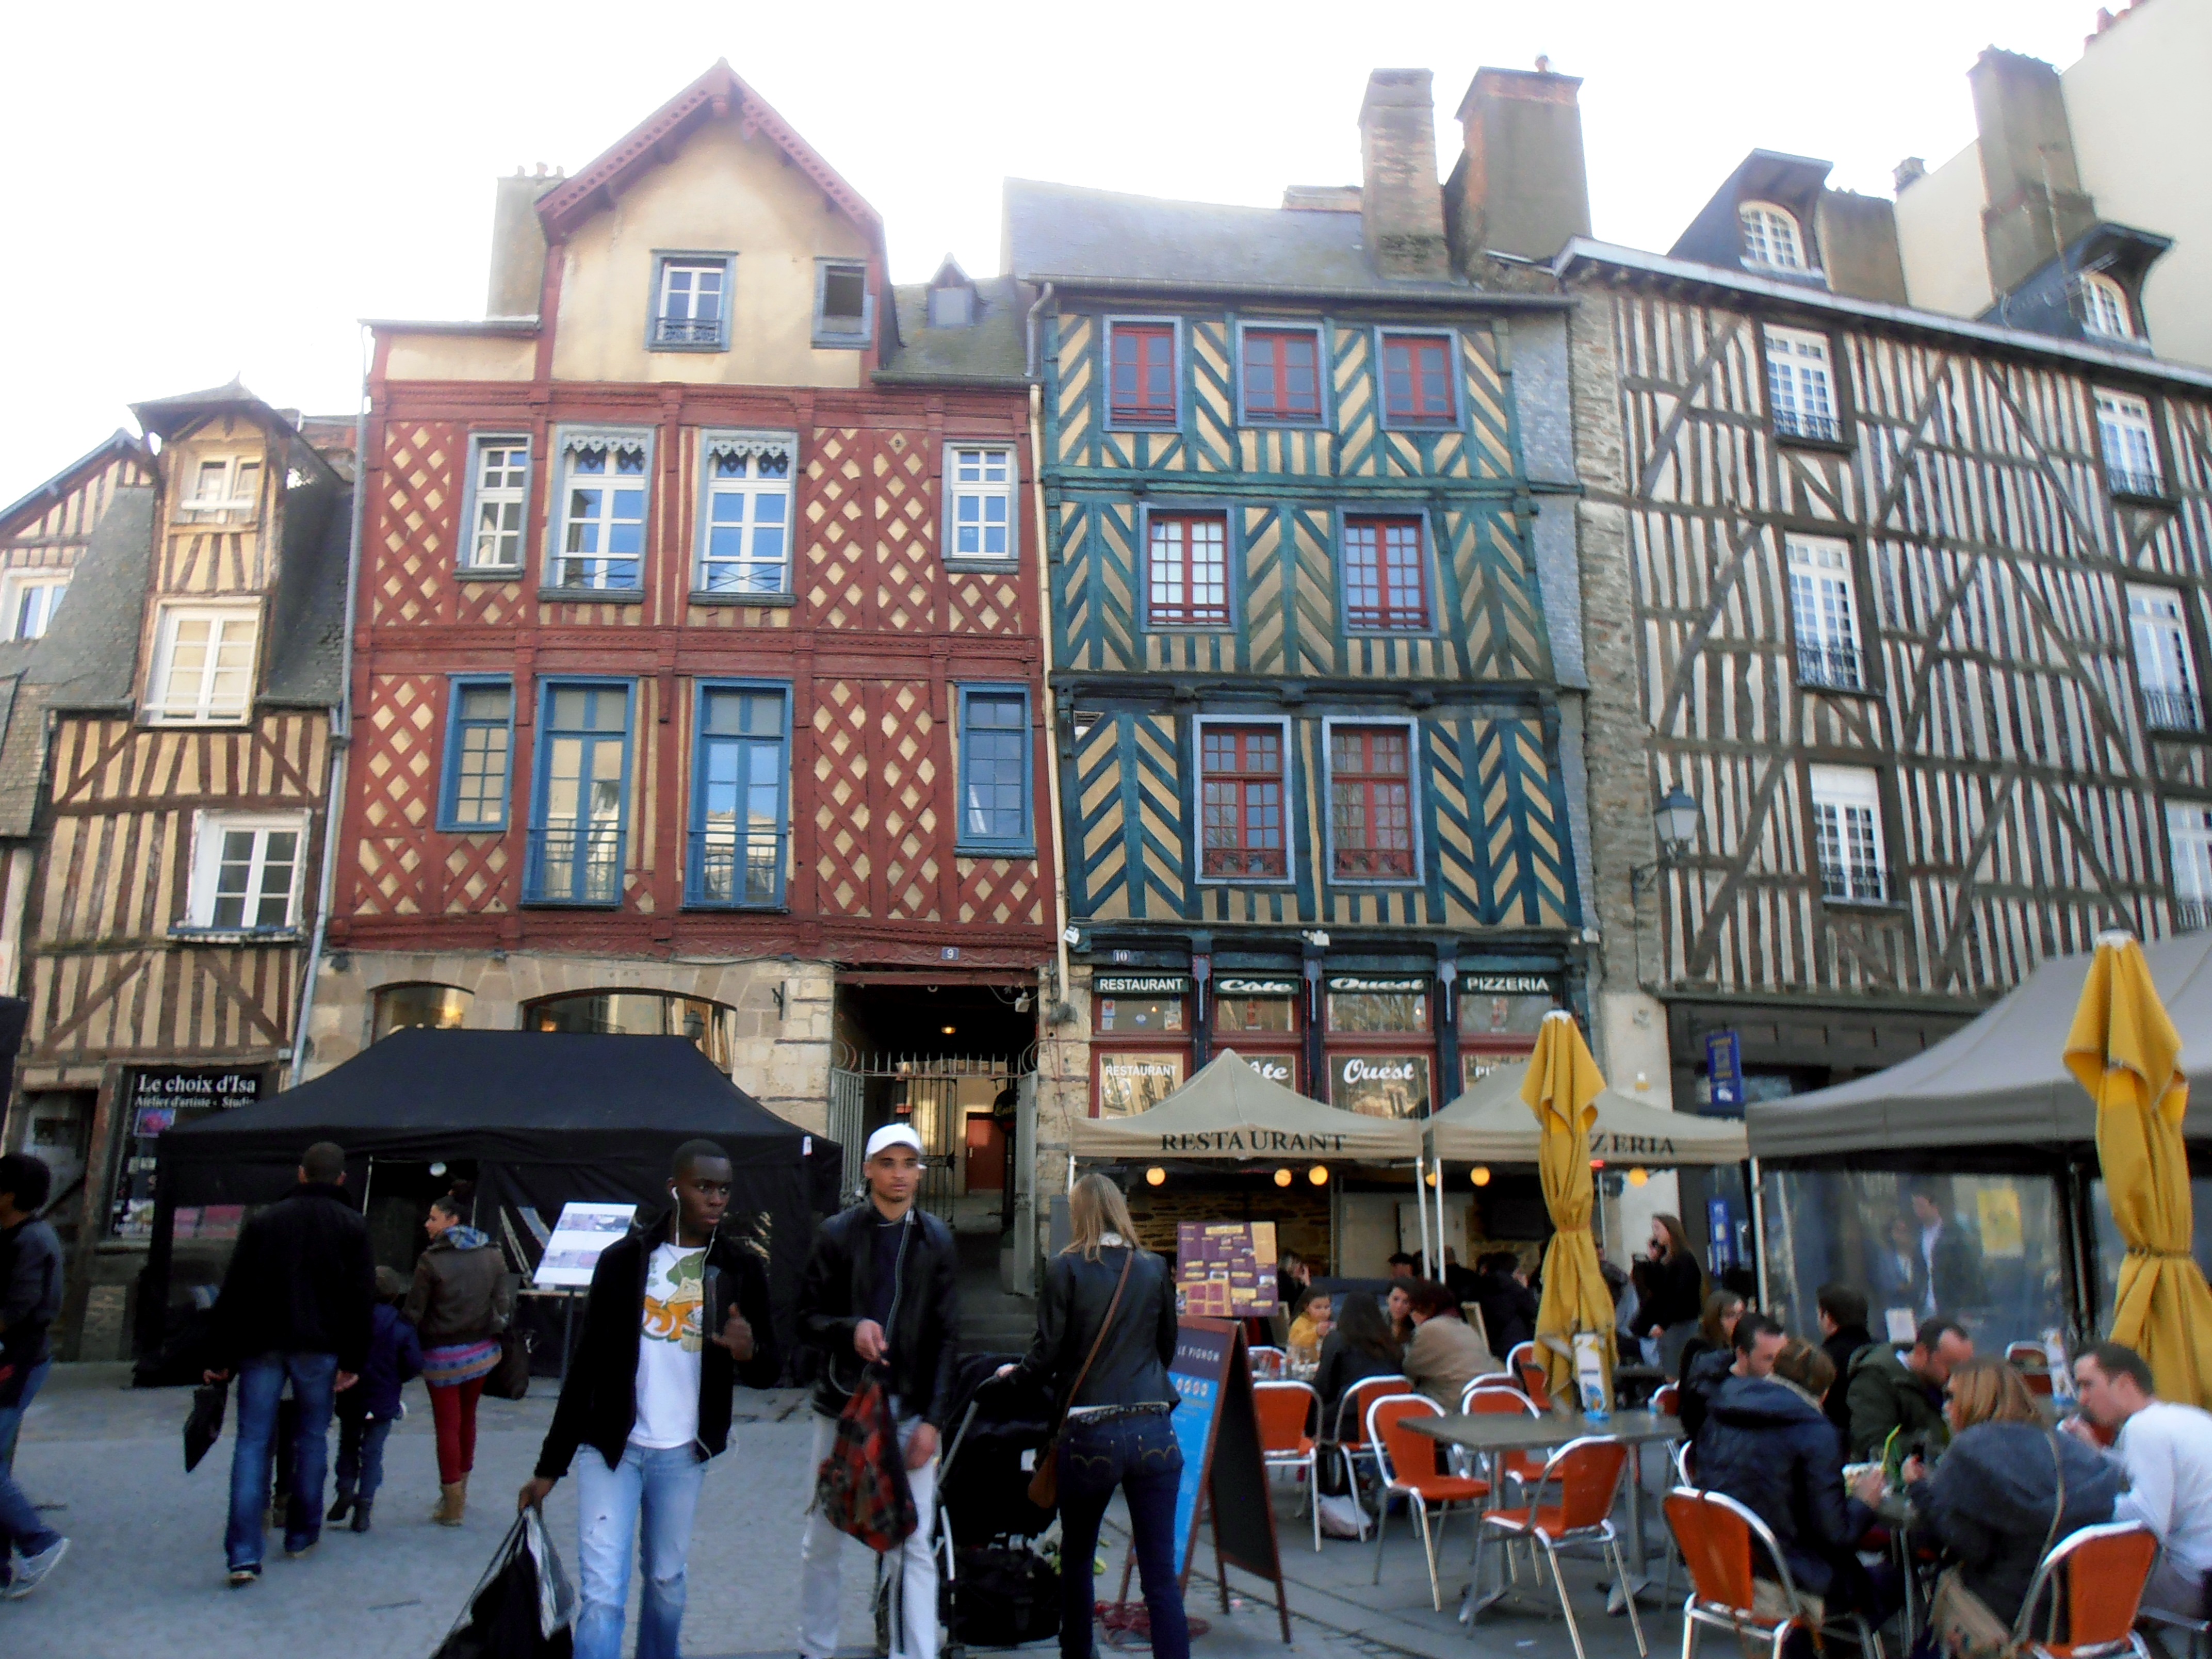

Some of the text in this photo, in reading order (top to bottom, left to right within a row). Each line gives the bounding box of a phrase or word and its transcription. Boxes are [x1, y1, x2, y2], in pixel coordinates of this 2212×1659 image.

[947, 949, 954, 958] 9
[1115, 950, 1128, 961] 10
[1099, 978, 1183, 990] RESTAURANT
[1467, 977, 1550, 991] PIZZERIA
[1105, 1065, 1177, 1076] RESTAURANT
[1343, 1058, 1415, 1084] Ouest
[138, 1074, 256, 1094] Le choix d'Isa
[135, 1095, 170, 1108] Atelier
[1161, 1130, 1347, 1151] RESTAURANT
[1590, 1134, 1674, 1154] ZERIA
